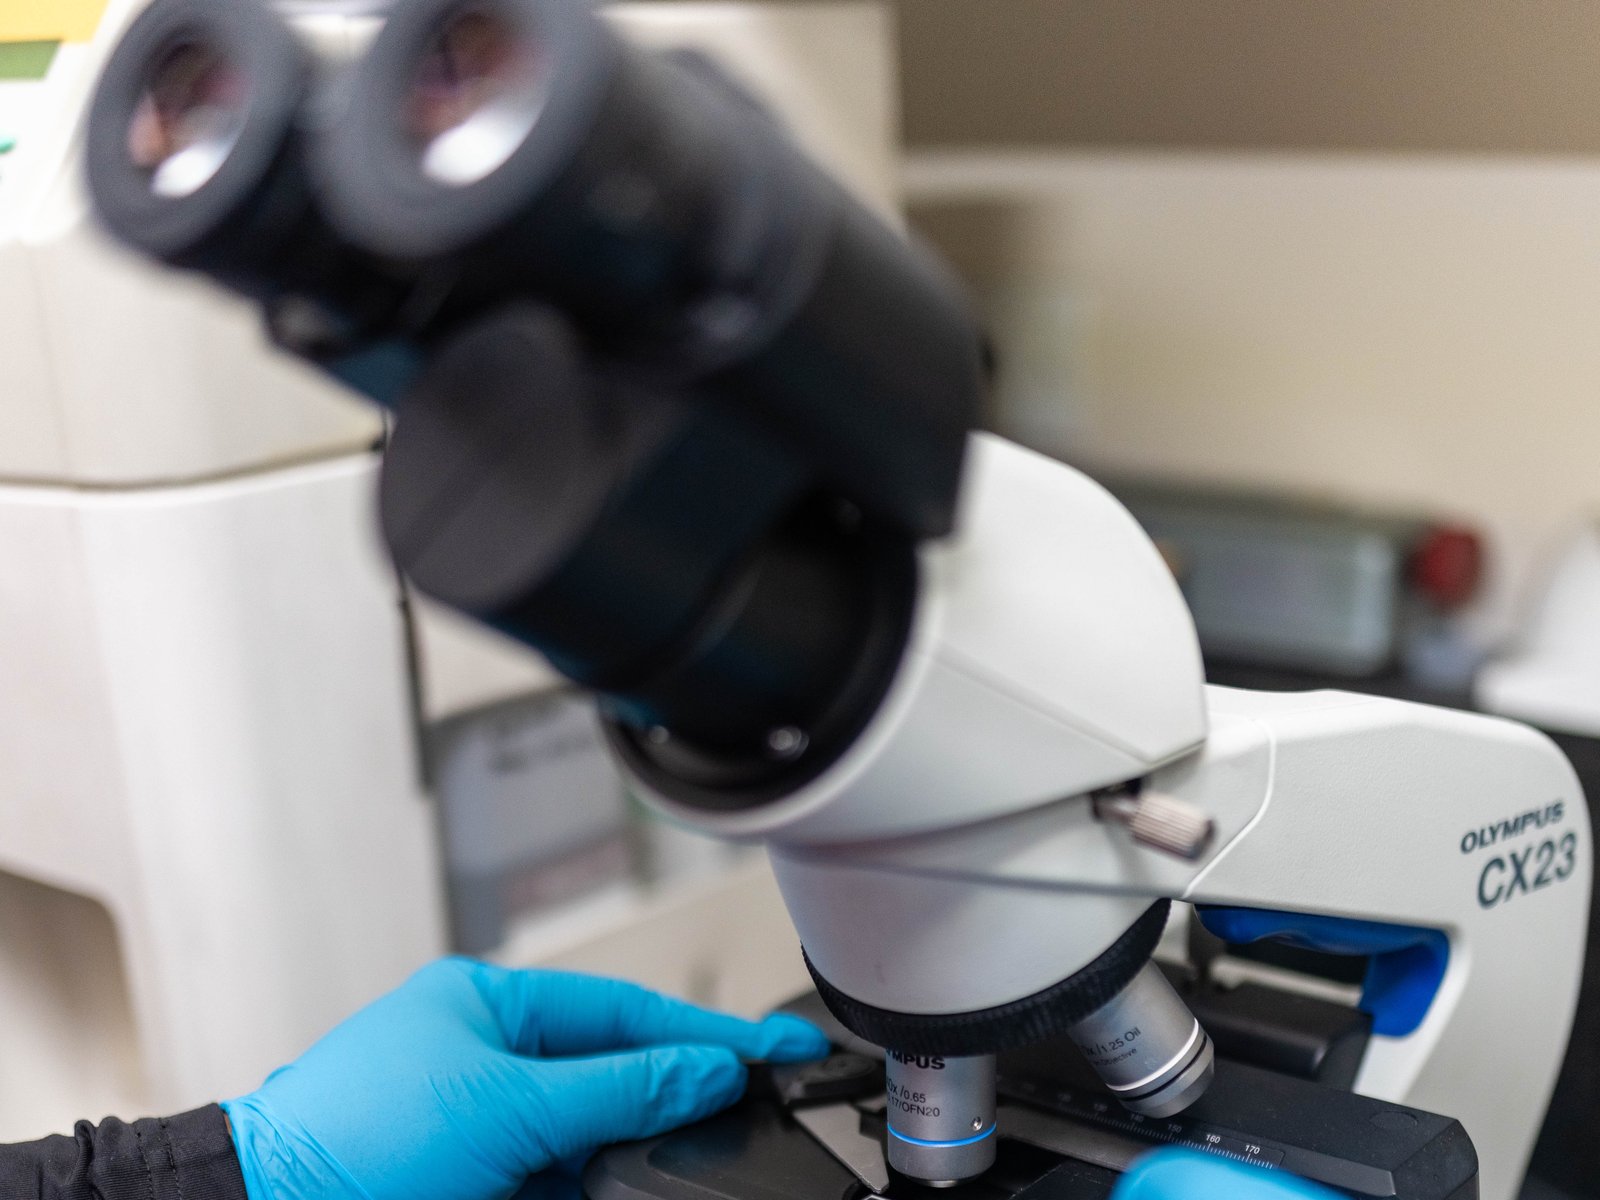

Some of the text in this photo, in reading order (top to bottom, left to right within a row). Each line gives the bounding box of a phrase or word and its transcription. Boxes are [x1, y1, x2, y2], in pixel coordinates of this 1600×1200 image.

[1460, 801, 1564, 854] OLYMPUS
[1478, 831, 1576, 909] CX23
[1124, 1027, 1142, 1042] Oil
[1206, 1133, 1221, 1144] 160
[1245, 1144, 1260, 1155] 170
